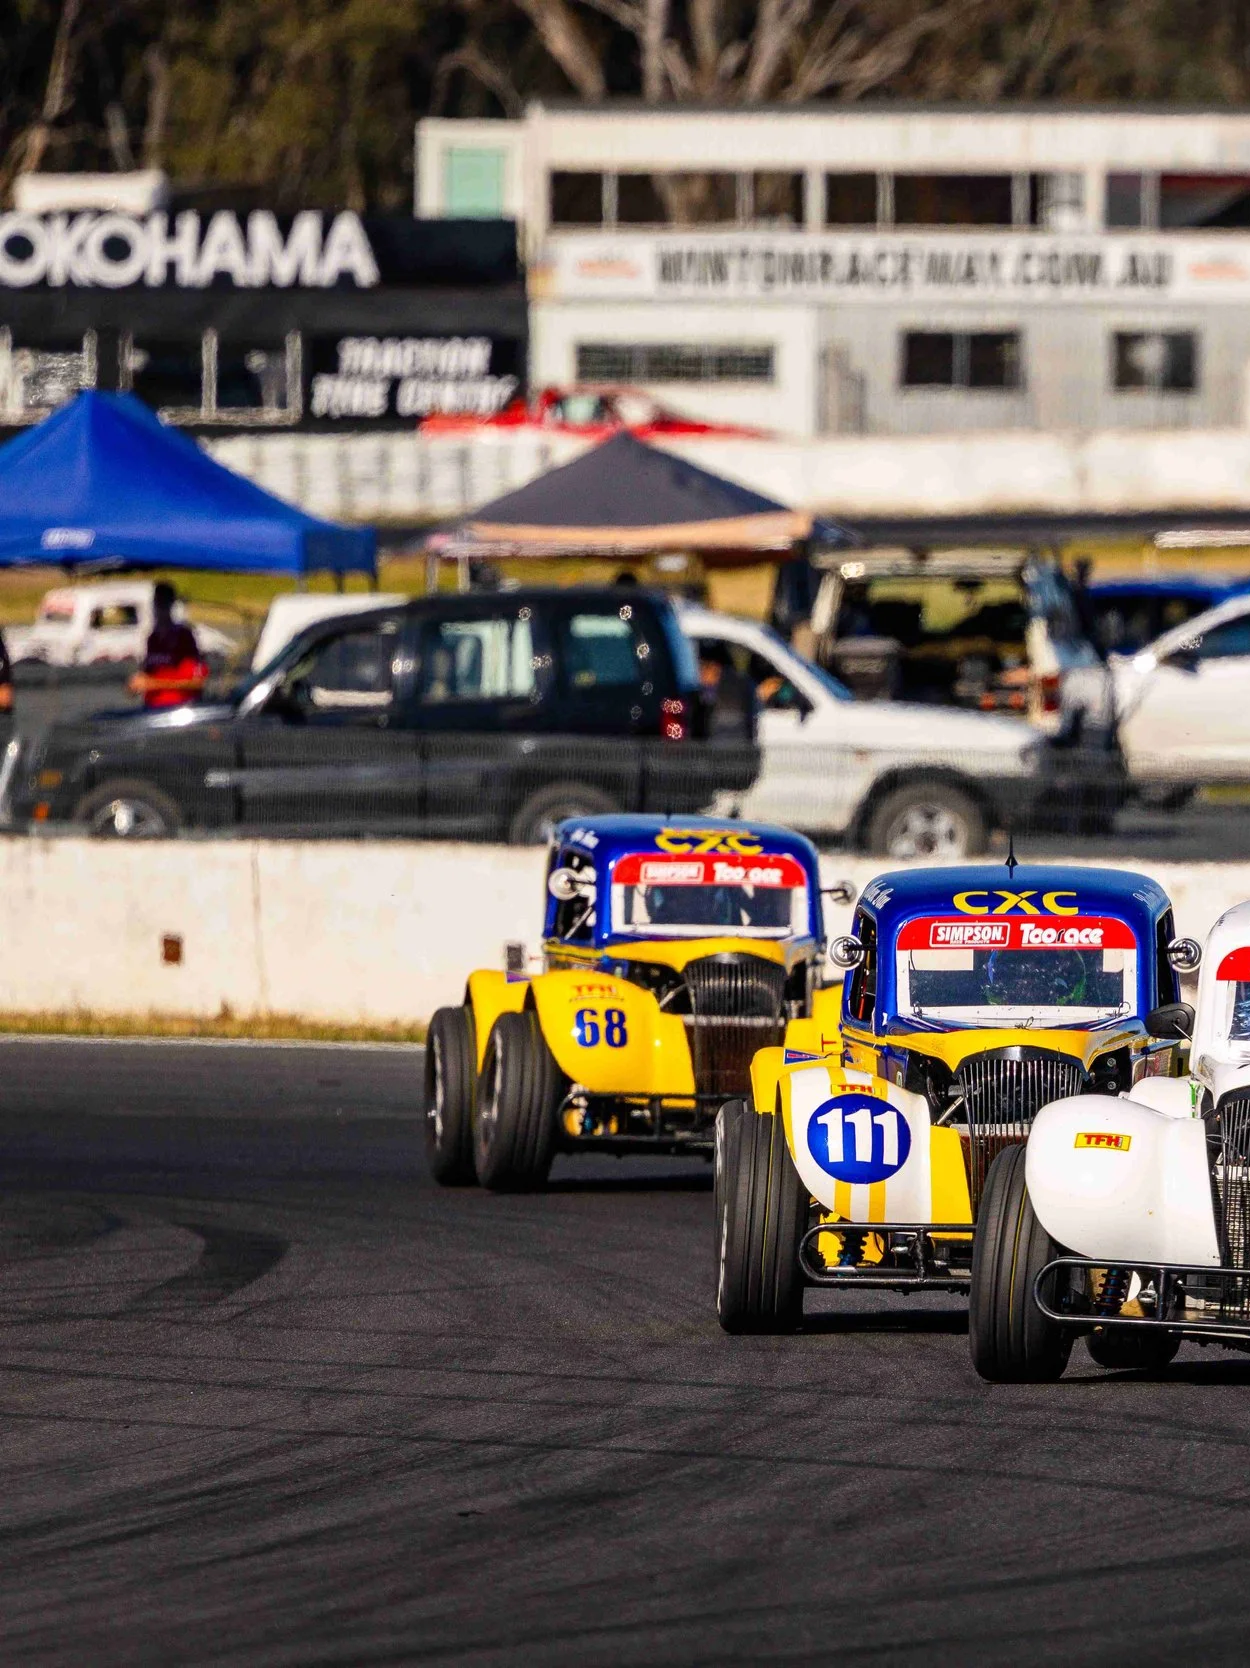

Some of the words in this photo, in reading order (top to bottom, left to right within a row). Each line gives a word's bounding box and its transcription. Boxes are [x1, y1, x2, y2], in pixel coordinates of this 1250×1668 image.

[952, 890, 1079, 915] CXC
[937, 926, 1003, 941] SIMPSON
[575, 1010, 628, 1049] 68
[838, 1084, 872, 1094] TFH
[817, 1107, 899, 1166] 111
[1084, 1134, 1120, 1147] TFH
